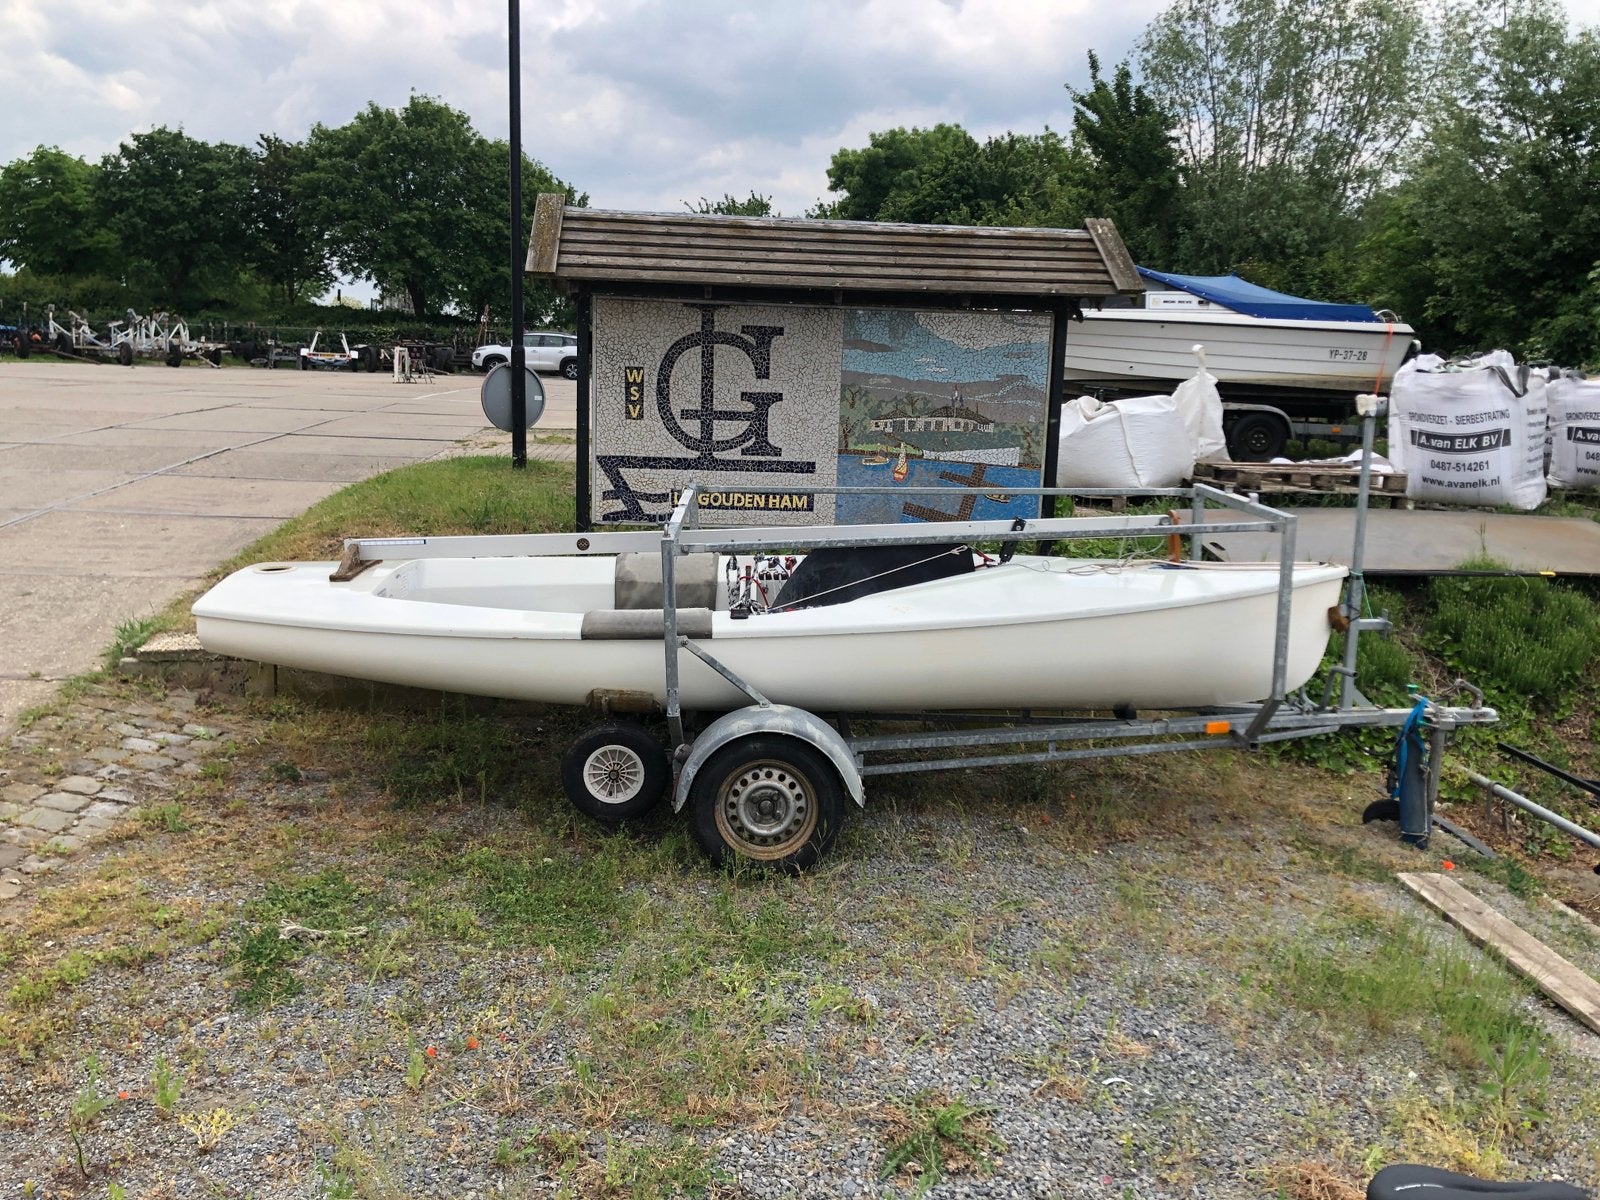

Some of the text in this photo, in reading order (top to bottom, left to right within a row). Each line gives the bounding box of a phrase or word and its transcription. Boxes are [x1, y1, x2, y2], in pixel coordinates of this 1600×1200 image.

[1329, 349, 1368, 361] YP-37-28
[1455, 409, 1510, 425] SIERBESTRATING
[1455, 438, 1478, 449] ELK
[1482, 434, 1499, 447] BV
[1430, 459, 1490, 472] 0487-514261
[1422, 475, 1500, 489] www.avanelk.nl
[698, 492, 764, 508] GOUDEN
[768, 494, 808, 509] HAM
